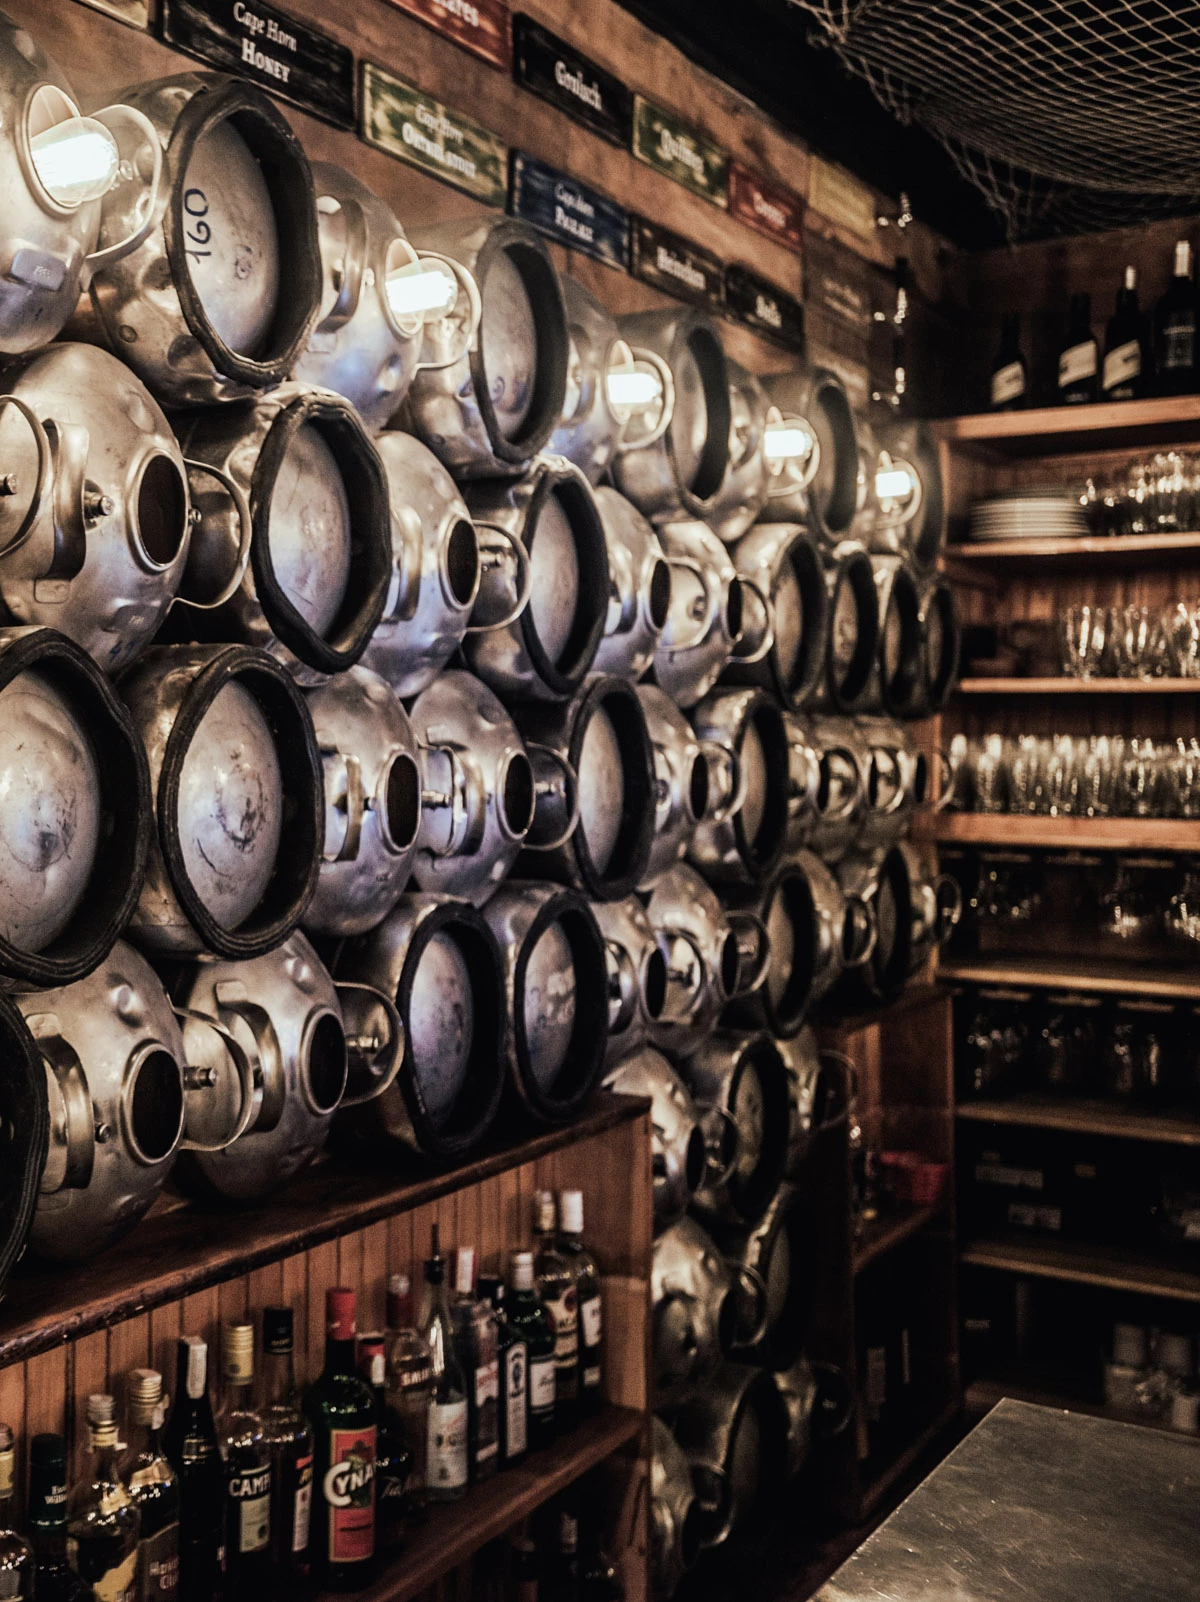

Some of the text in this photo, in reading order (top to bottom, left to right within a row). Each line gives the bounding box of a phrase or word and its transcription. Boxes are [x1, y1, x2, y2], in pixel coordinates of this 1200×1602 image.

[233, 2, 297, 52] Cape Horn
[323, 1461, 375, 1506] CYNA
